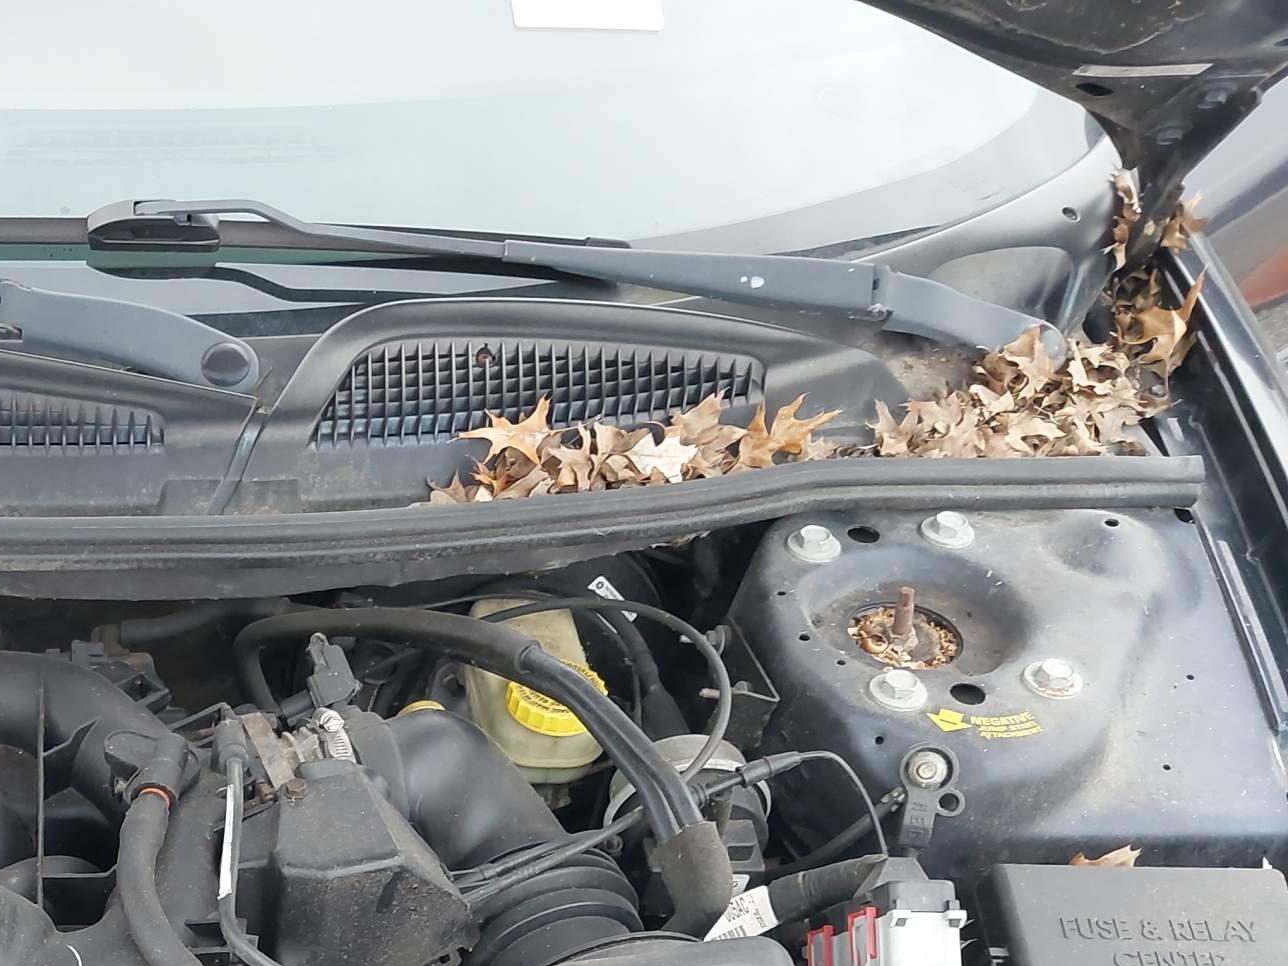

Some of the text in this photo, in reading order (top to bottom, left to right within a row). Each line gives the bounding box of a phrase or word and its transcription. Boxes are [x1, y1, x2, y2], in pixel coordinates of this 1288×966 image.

[970, 711, 1035, 725] NEGATIVE
[1059, 917, 1257, 942] FUSE & RELAY
